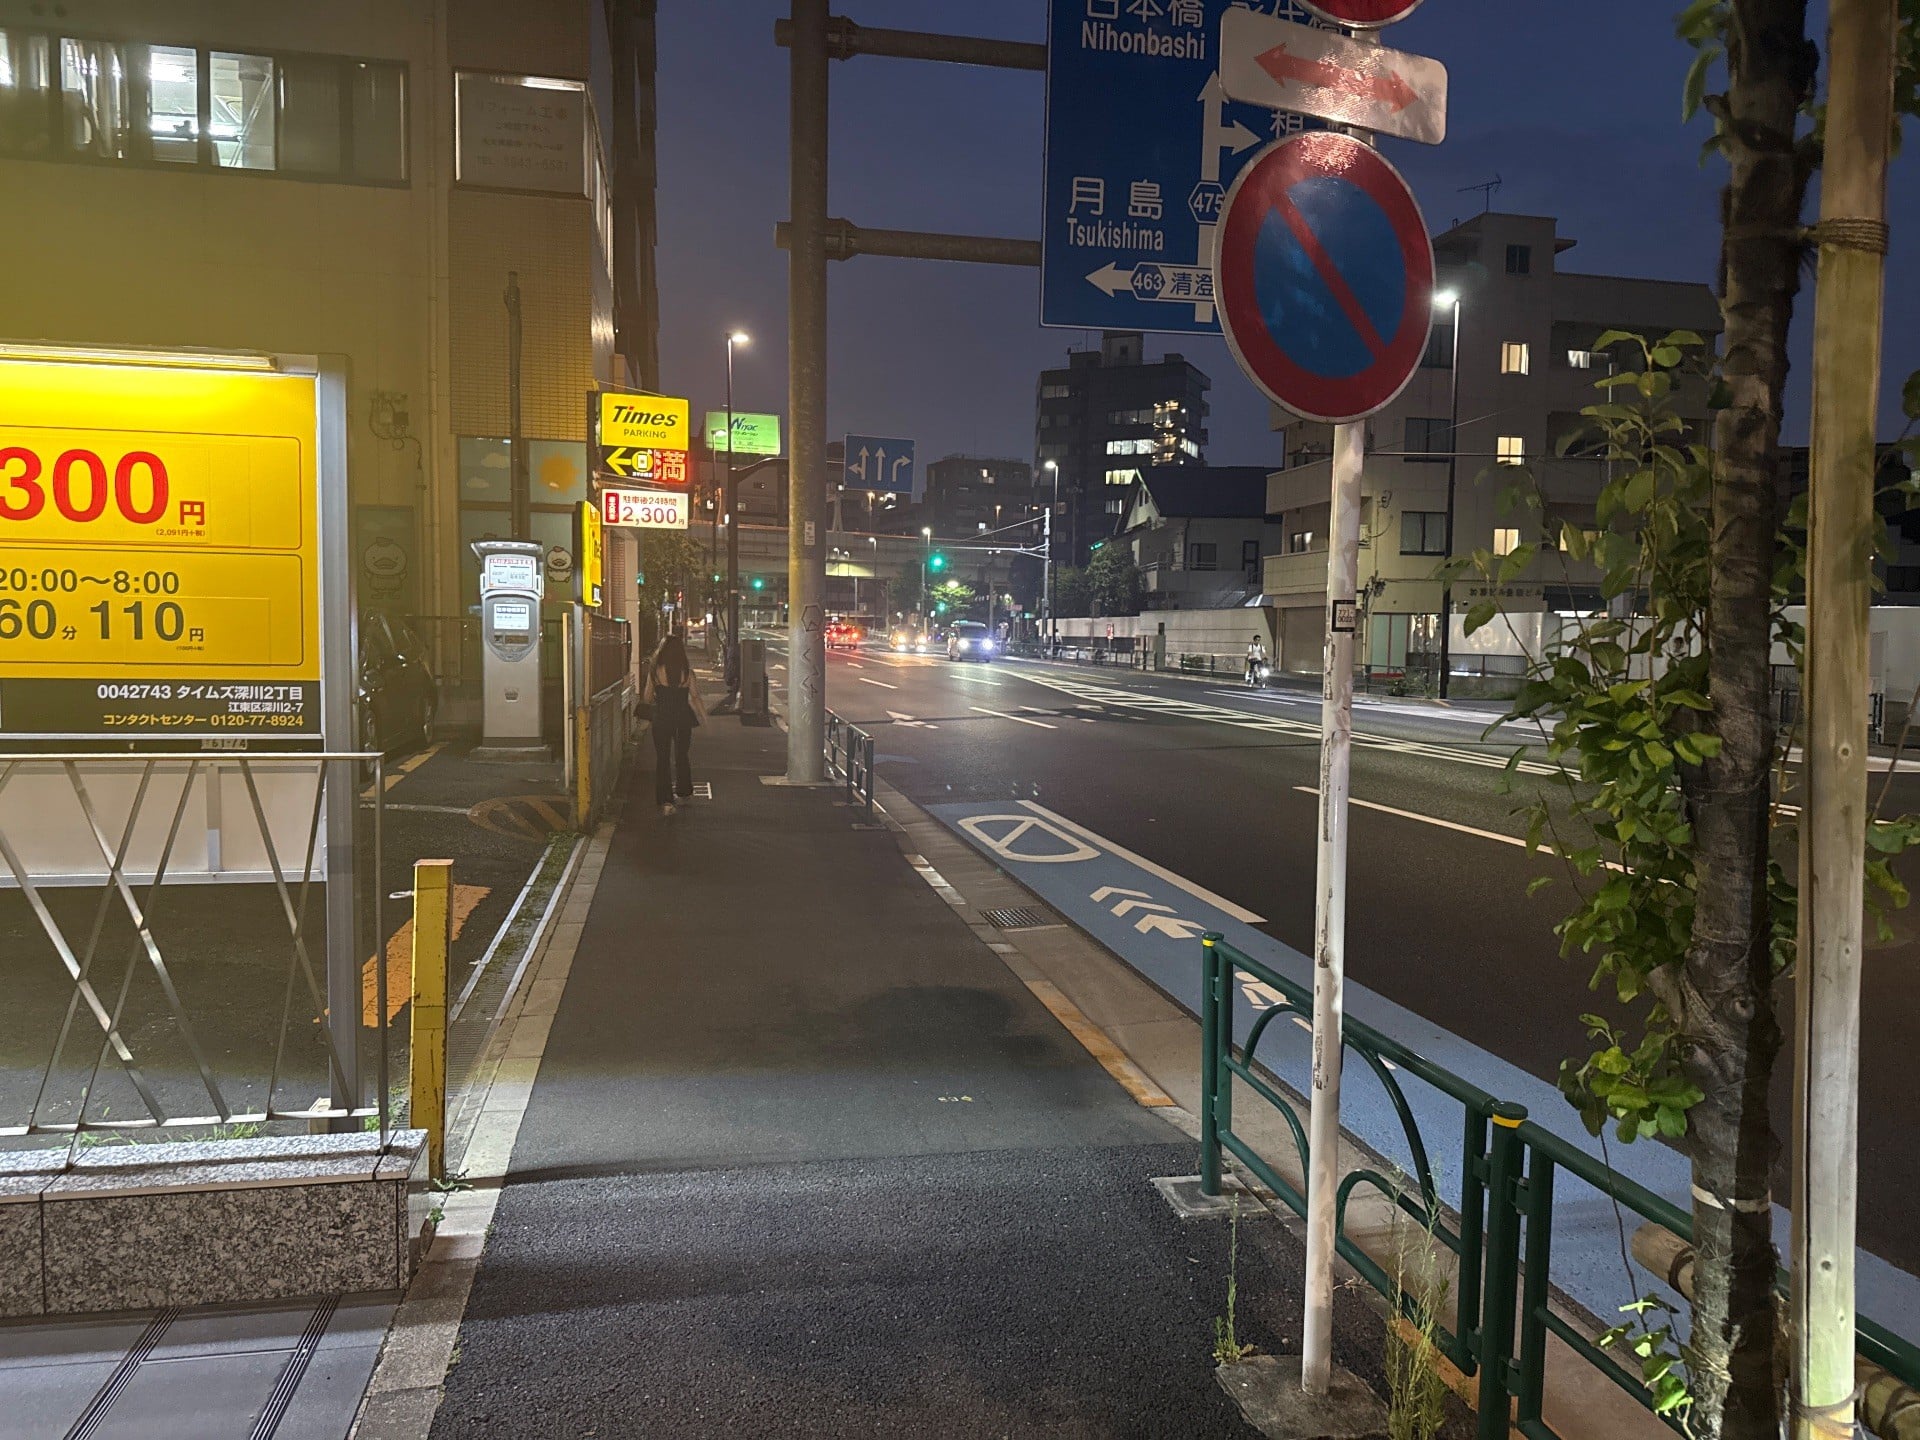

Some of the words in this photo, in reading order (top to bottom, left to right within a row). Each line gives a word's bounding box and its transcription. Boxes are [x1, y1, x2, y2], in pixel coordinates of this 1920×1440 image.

[1082, 20, 1205, 60] Nihonbashi
[1068, 176, 1164, 220] 月島
[1193, 192, 1226, 214] 475
[1067, 217, 1164, 251] Tsukishima
[1133, 272, 1163, 291] 463
[612, 405, 679, 427] Times
[623, 428, 667, 439] PARKING
[97, 684, 172, 700] 0042743
[177, 685, 303, 701] タイムズ深川2丁目
[228, 702, 304, 713] 江東区深川2-7
[103, 713, 207, 727] コンタクトセンター
[210, 714, 304, 727] 0120-77-8924
